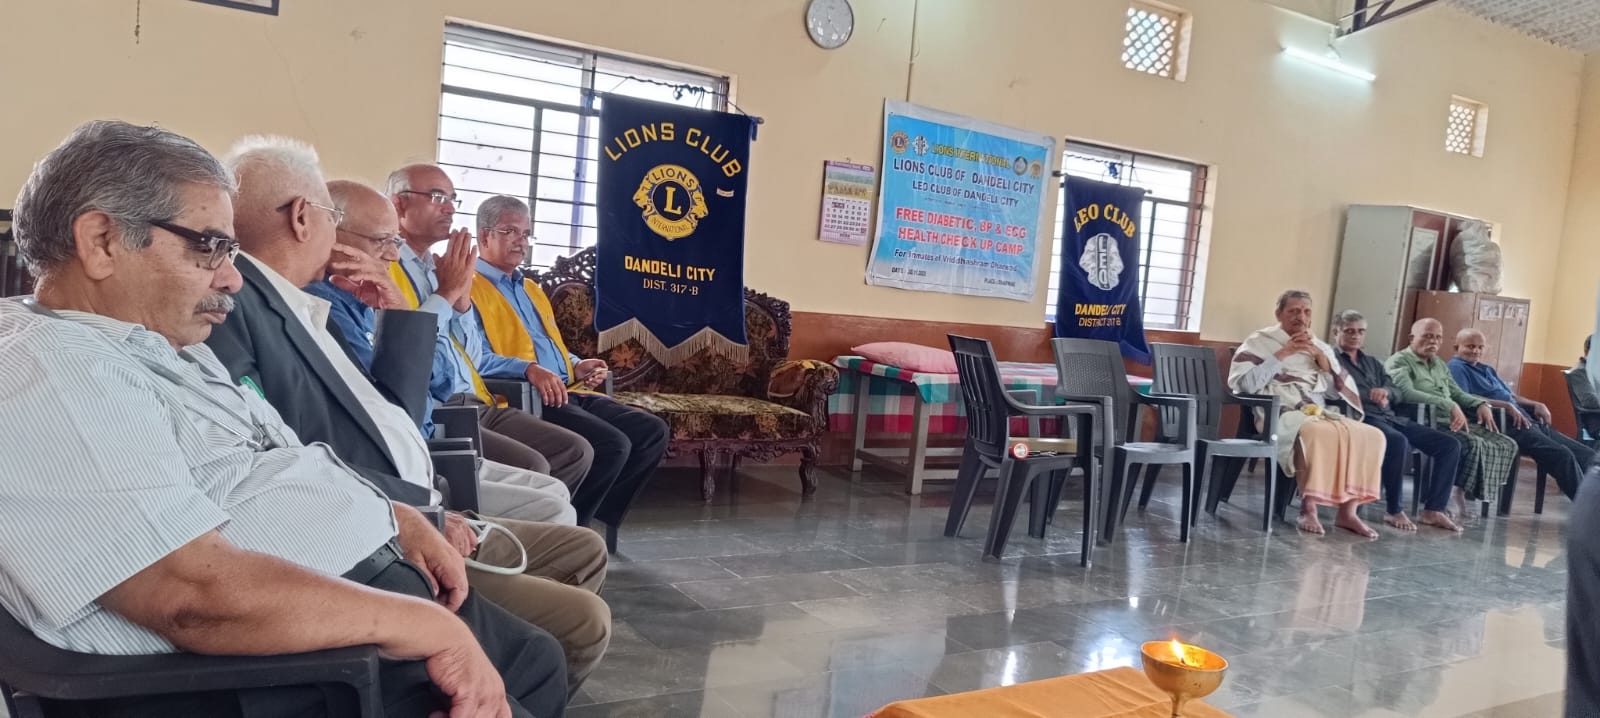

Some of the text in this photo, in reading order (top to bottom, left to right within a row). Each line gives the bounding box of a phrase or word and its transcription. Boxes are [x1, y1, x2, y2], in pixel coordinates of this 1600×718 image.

[604, 122, 742, 178] LIONS CLUB
[933, 143, 954, 158] LIONS
[652, 168, 695, 188] LIONS
[893, 158, 1035, 195] LIONS CLUB OF DANDELI CITY
[663, 186, 682, 215] L
[912, 180, 928, 192] LEO
[930, 183, 952, 196] CLUB
[952, 187, 963, 198] OF
[963, 190, 998, 204] DANDELI
[1000, 196, 1020, 208] CITY
[651, 216, 690, 234] INTERNATIONAL
[896, 206, 925, 223] FREE
[926, 211, 978, 233] DIABETIC,
[979, 220, 994, 234] BP
[1074, 203, 1136, 238] LEO CLUB
[894, 248, 907, 259] For
[907, 250, 934, 262] Inmates
[897, 226, 1024, 256] HEALTH CHECK UP CAMP
[624, 255, 716, 282] DANDELI CITY
[1099, 236, 1108, 285] LEO
[643, 277, 668, 292] DIST.
